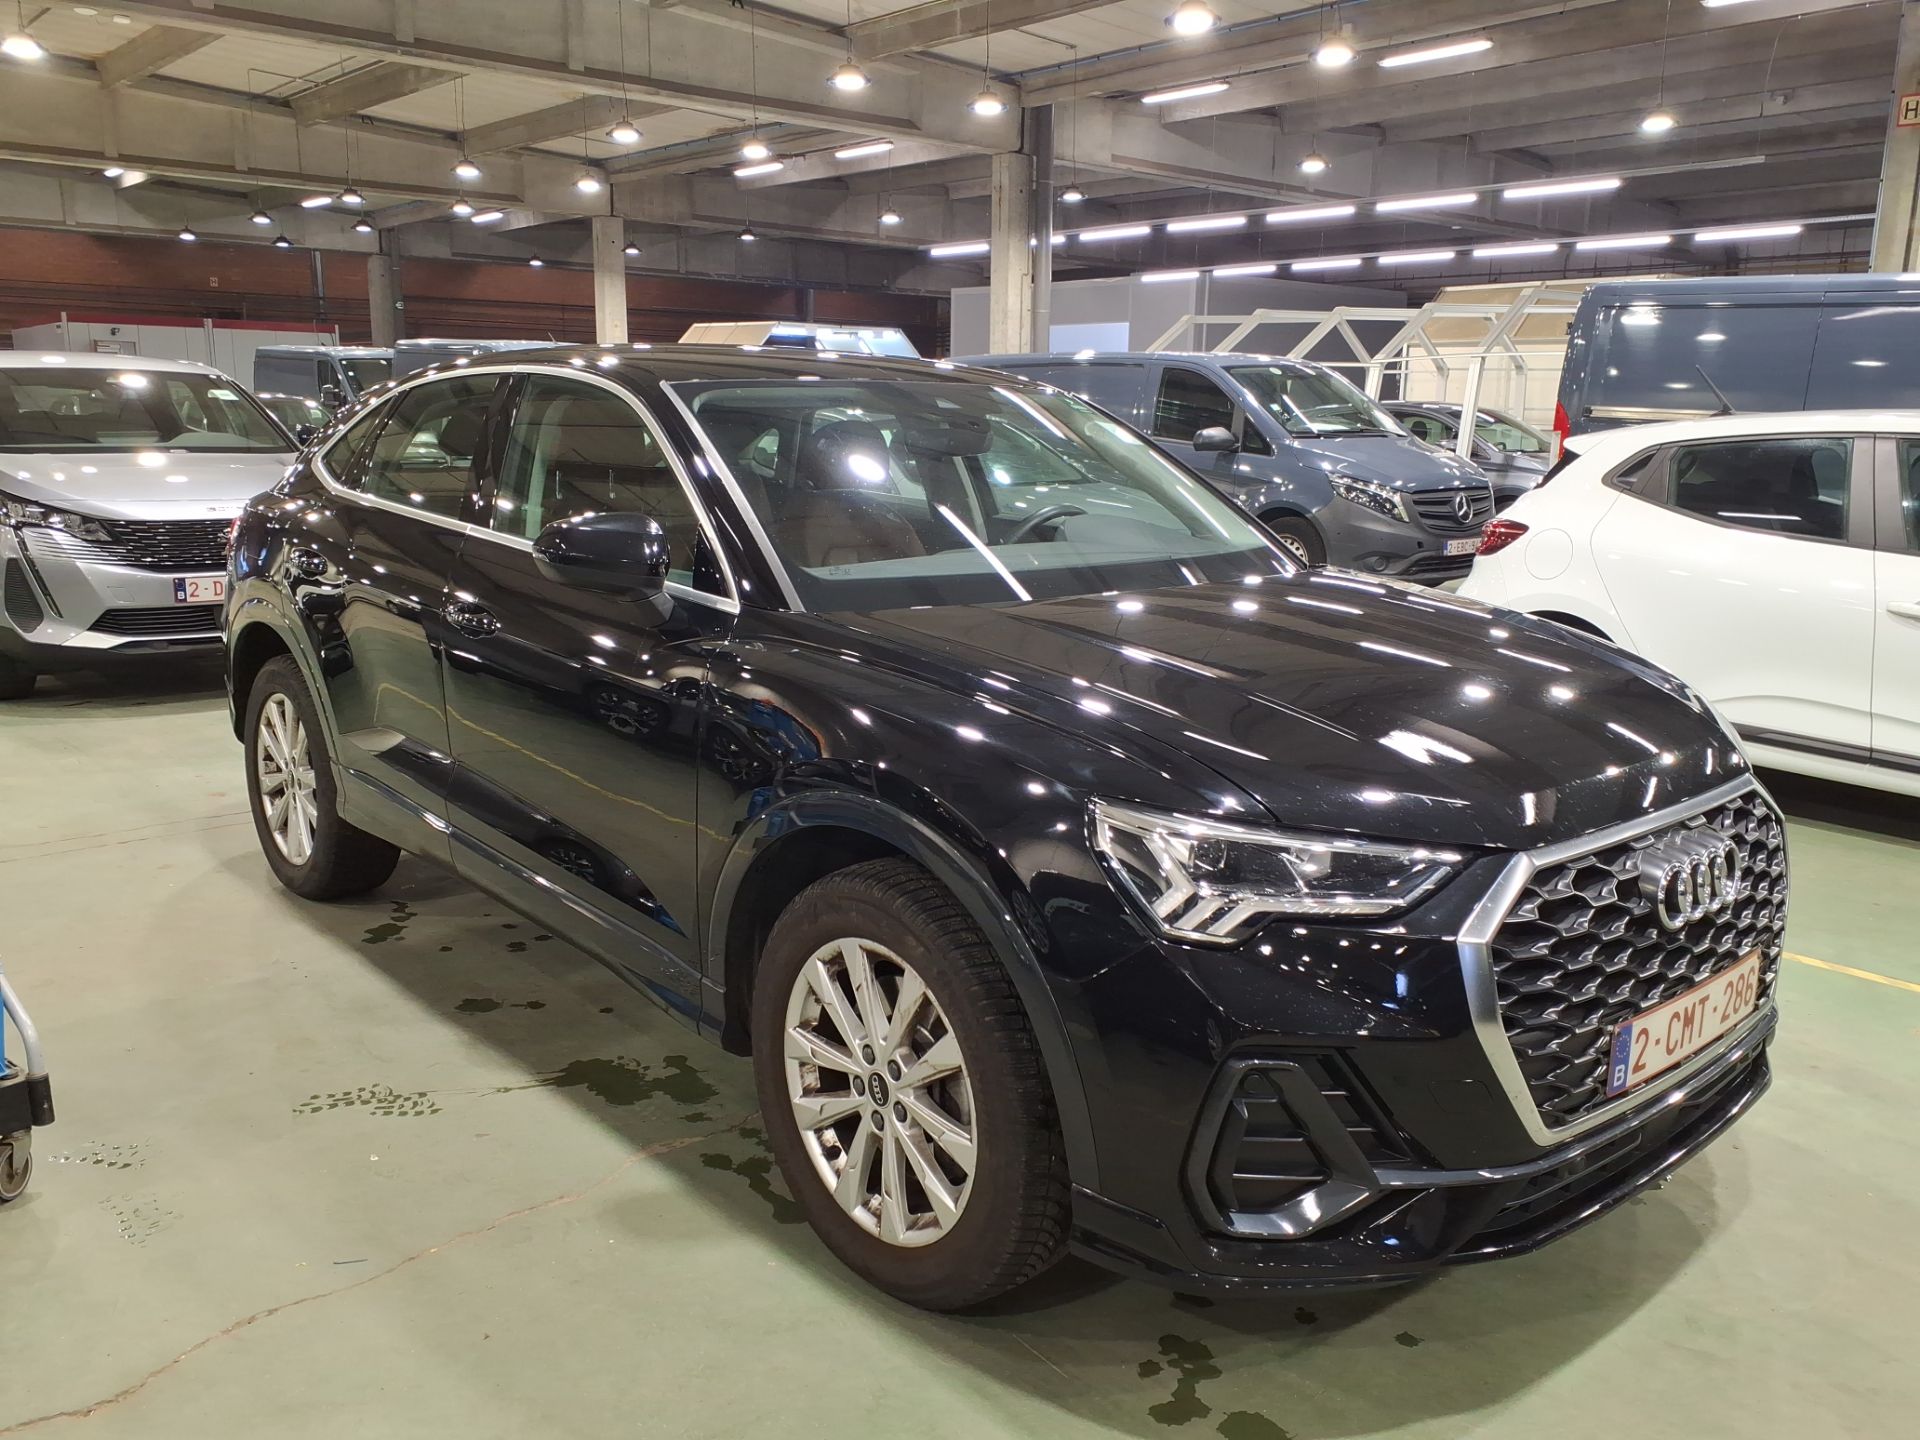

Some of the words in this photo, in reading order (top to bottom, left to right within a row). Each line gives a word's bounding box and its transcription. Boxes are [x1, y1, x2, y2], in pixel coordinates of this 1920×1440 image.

[1904, 100, 1919, 120] H
[1613, 1064, 1625, 1087] B
[1632, 966, 1755, 1075] 2-CMT-286
